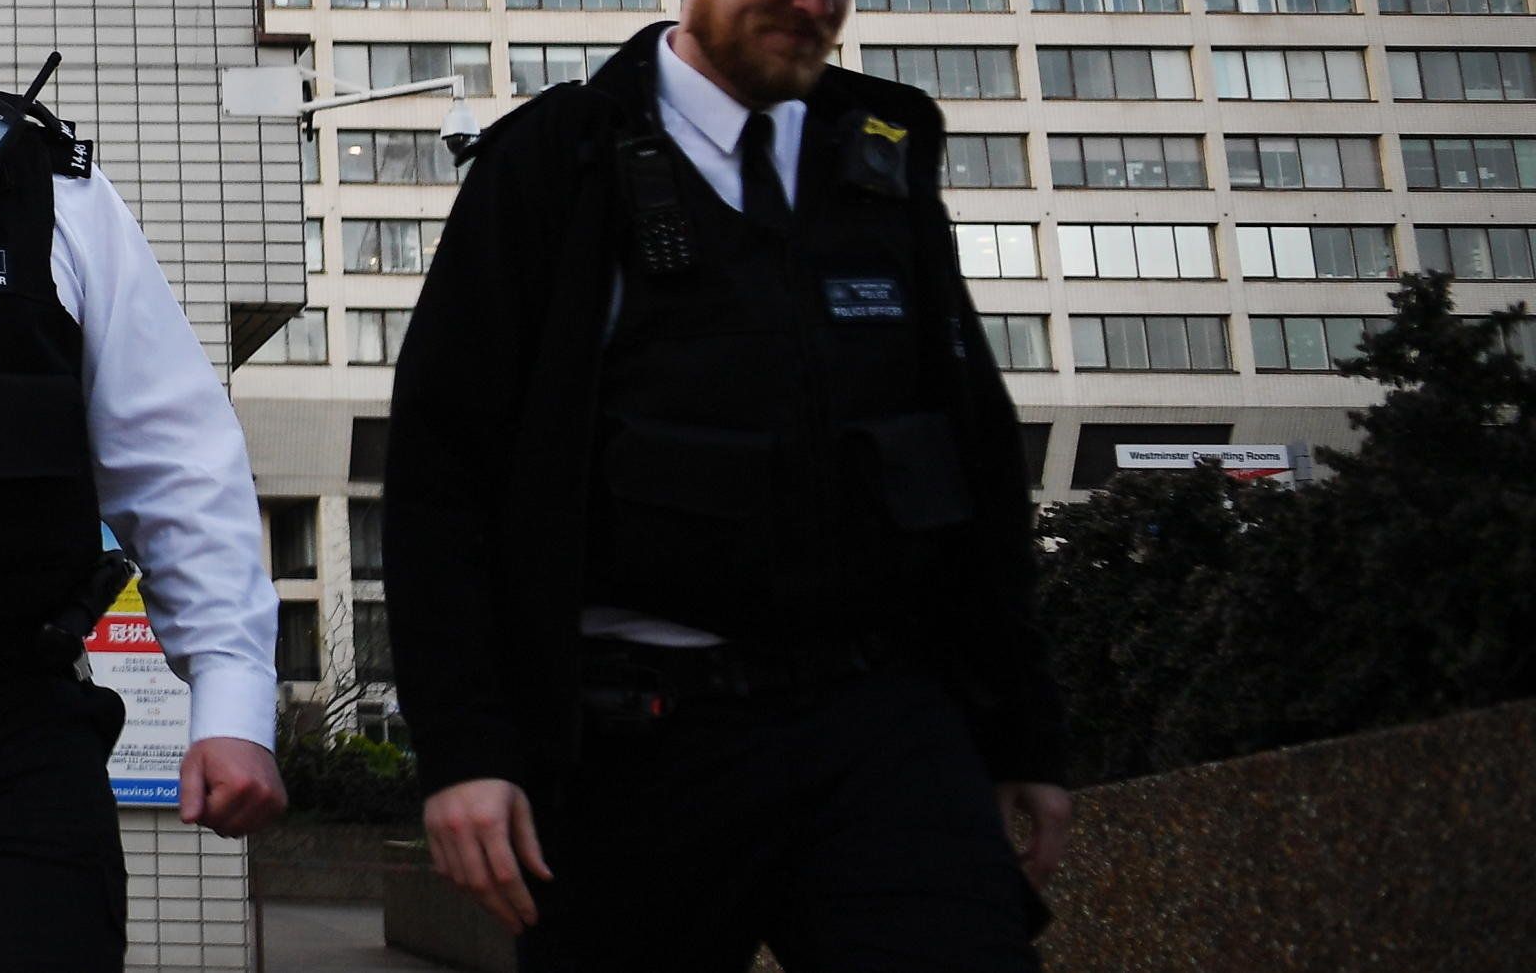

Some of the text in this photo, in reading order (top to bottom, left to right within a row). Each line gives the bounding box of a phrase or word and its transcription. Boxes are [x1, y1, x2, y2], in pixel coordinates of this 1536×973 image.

[1129, 451, 1189, 460] Westminster
[1247, 451, 1281, 460] Rooms
[157, 785, 177, 796] Pod
